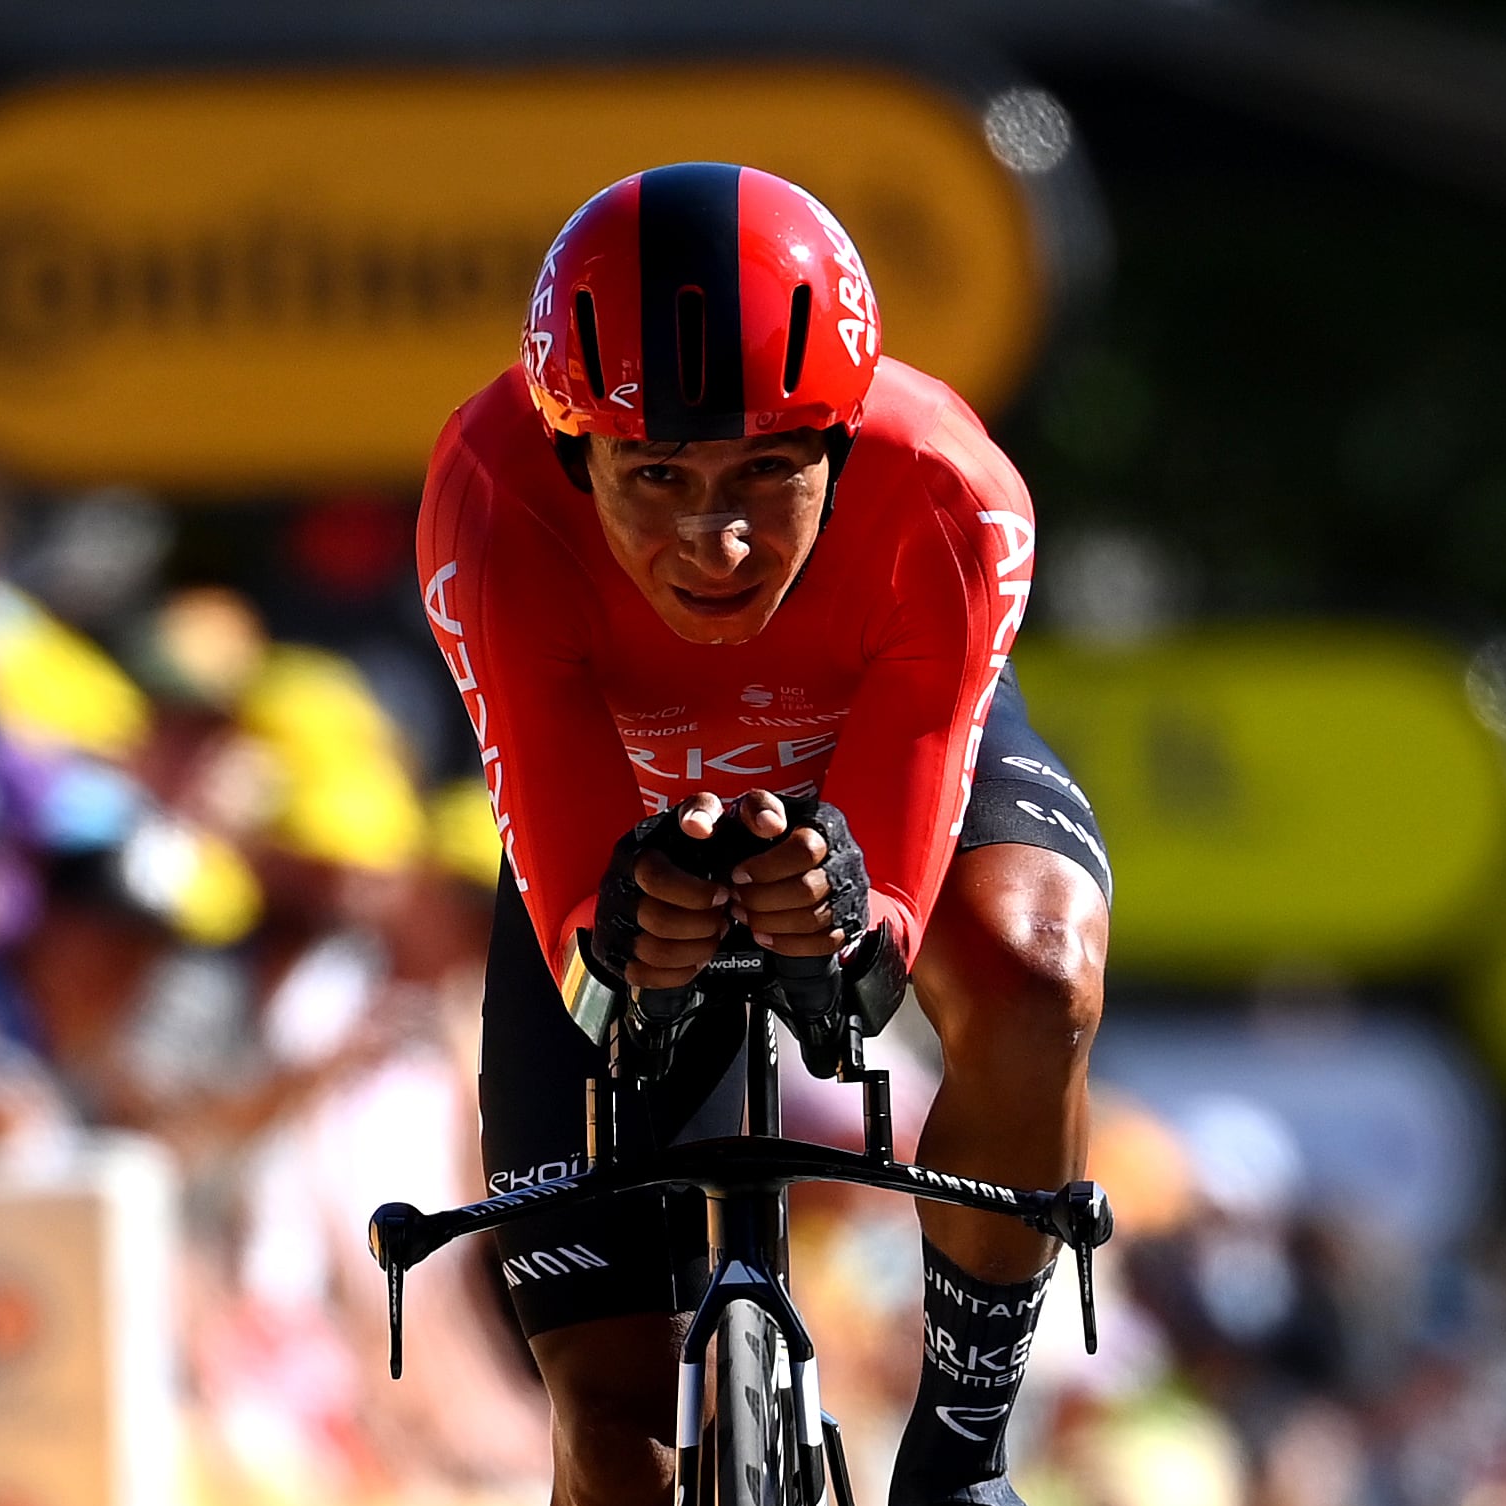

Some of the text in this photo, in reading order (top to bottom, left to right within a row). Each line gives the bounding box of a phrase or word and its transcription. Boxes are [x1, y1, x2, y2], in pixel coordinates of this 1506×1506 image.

[780, 685, 805, 696] UCI
[709, 955, 762, 970] wahoo
[906, 1165, 1018, 1205] CANYON
